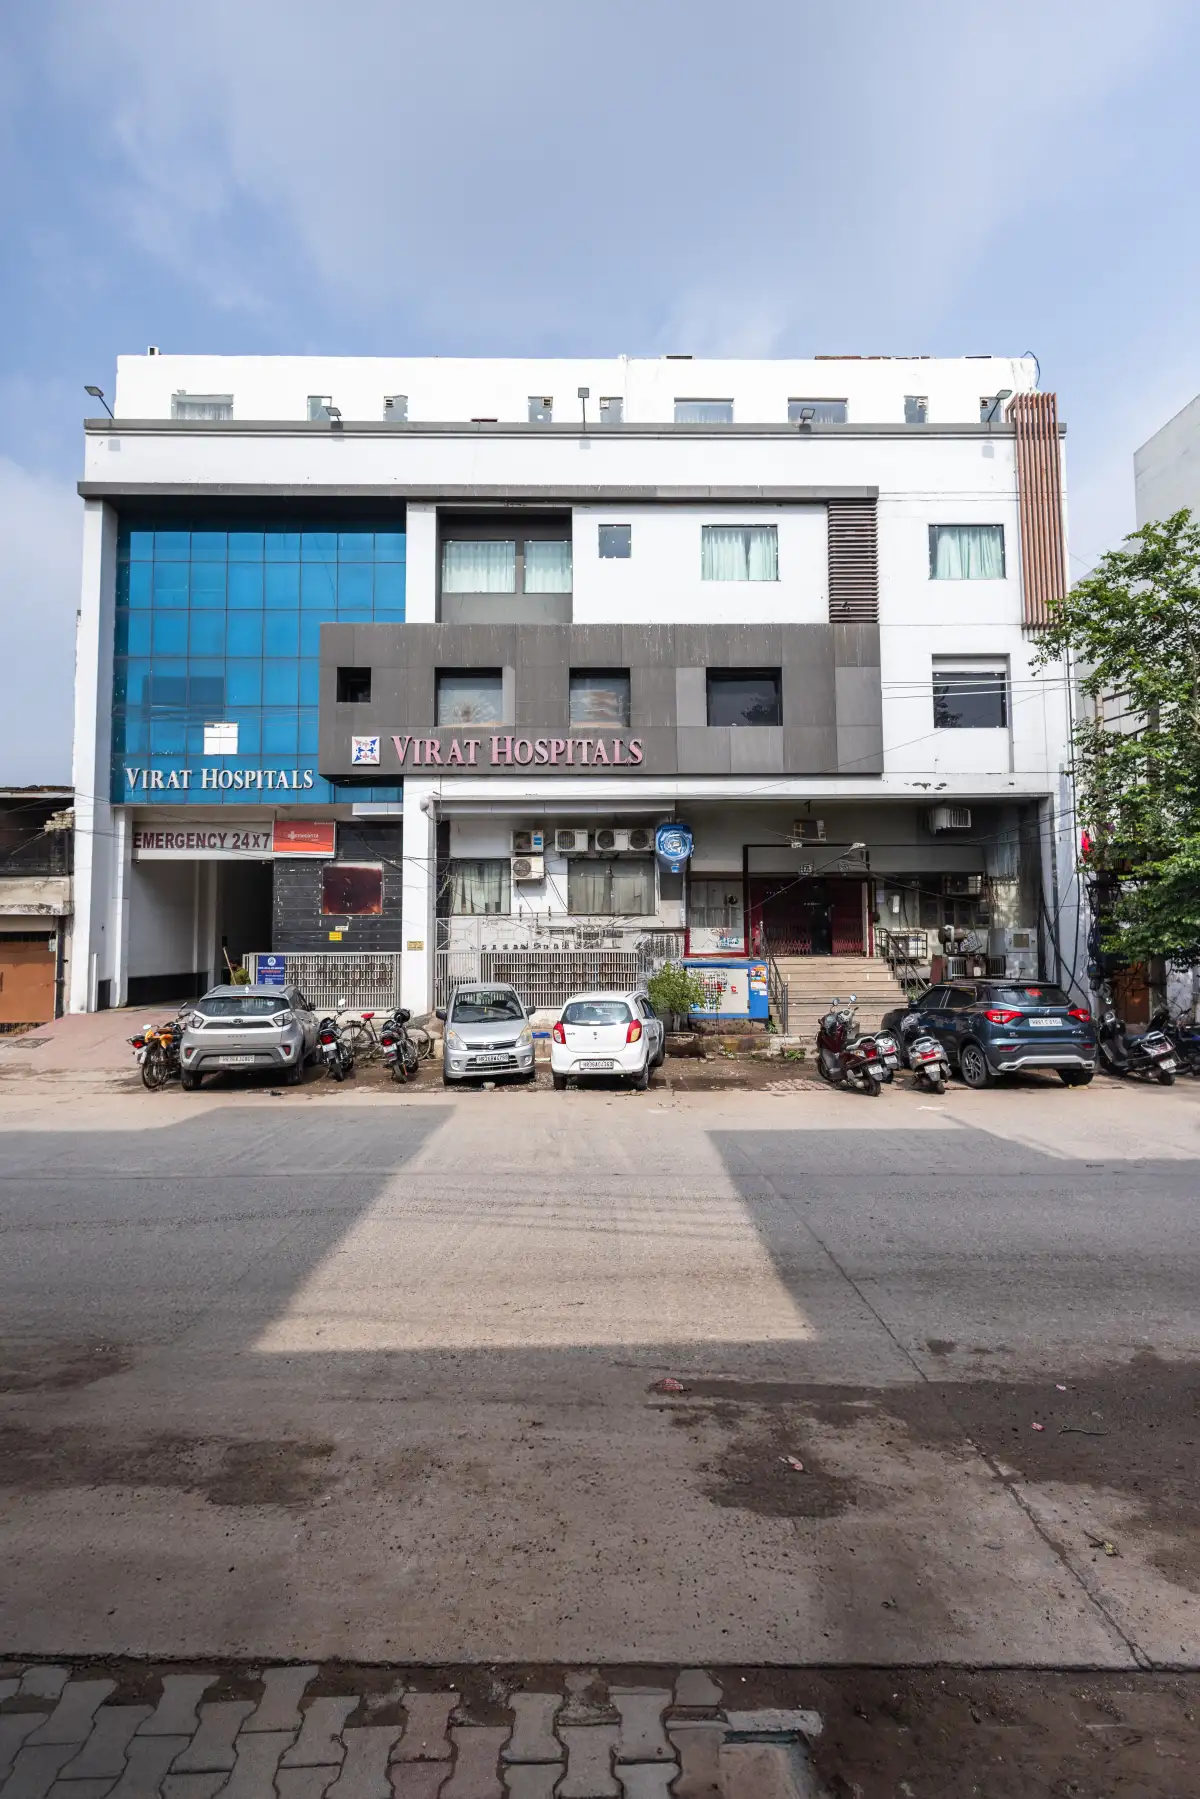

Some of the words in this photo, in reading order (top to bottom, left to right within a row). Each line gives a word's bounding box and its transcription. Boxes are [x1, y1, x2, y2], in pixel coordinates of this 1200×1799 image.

[391, 735, 481, 766] VIRAT
[489, 735, 644, 766] HOSPITALS
[124, 767, 192, 789] VIRAT
[200, 767, 314, 790] HOSPITALS
[132, 832, 228, 849] EMERGENCY
